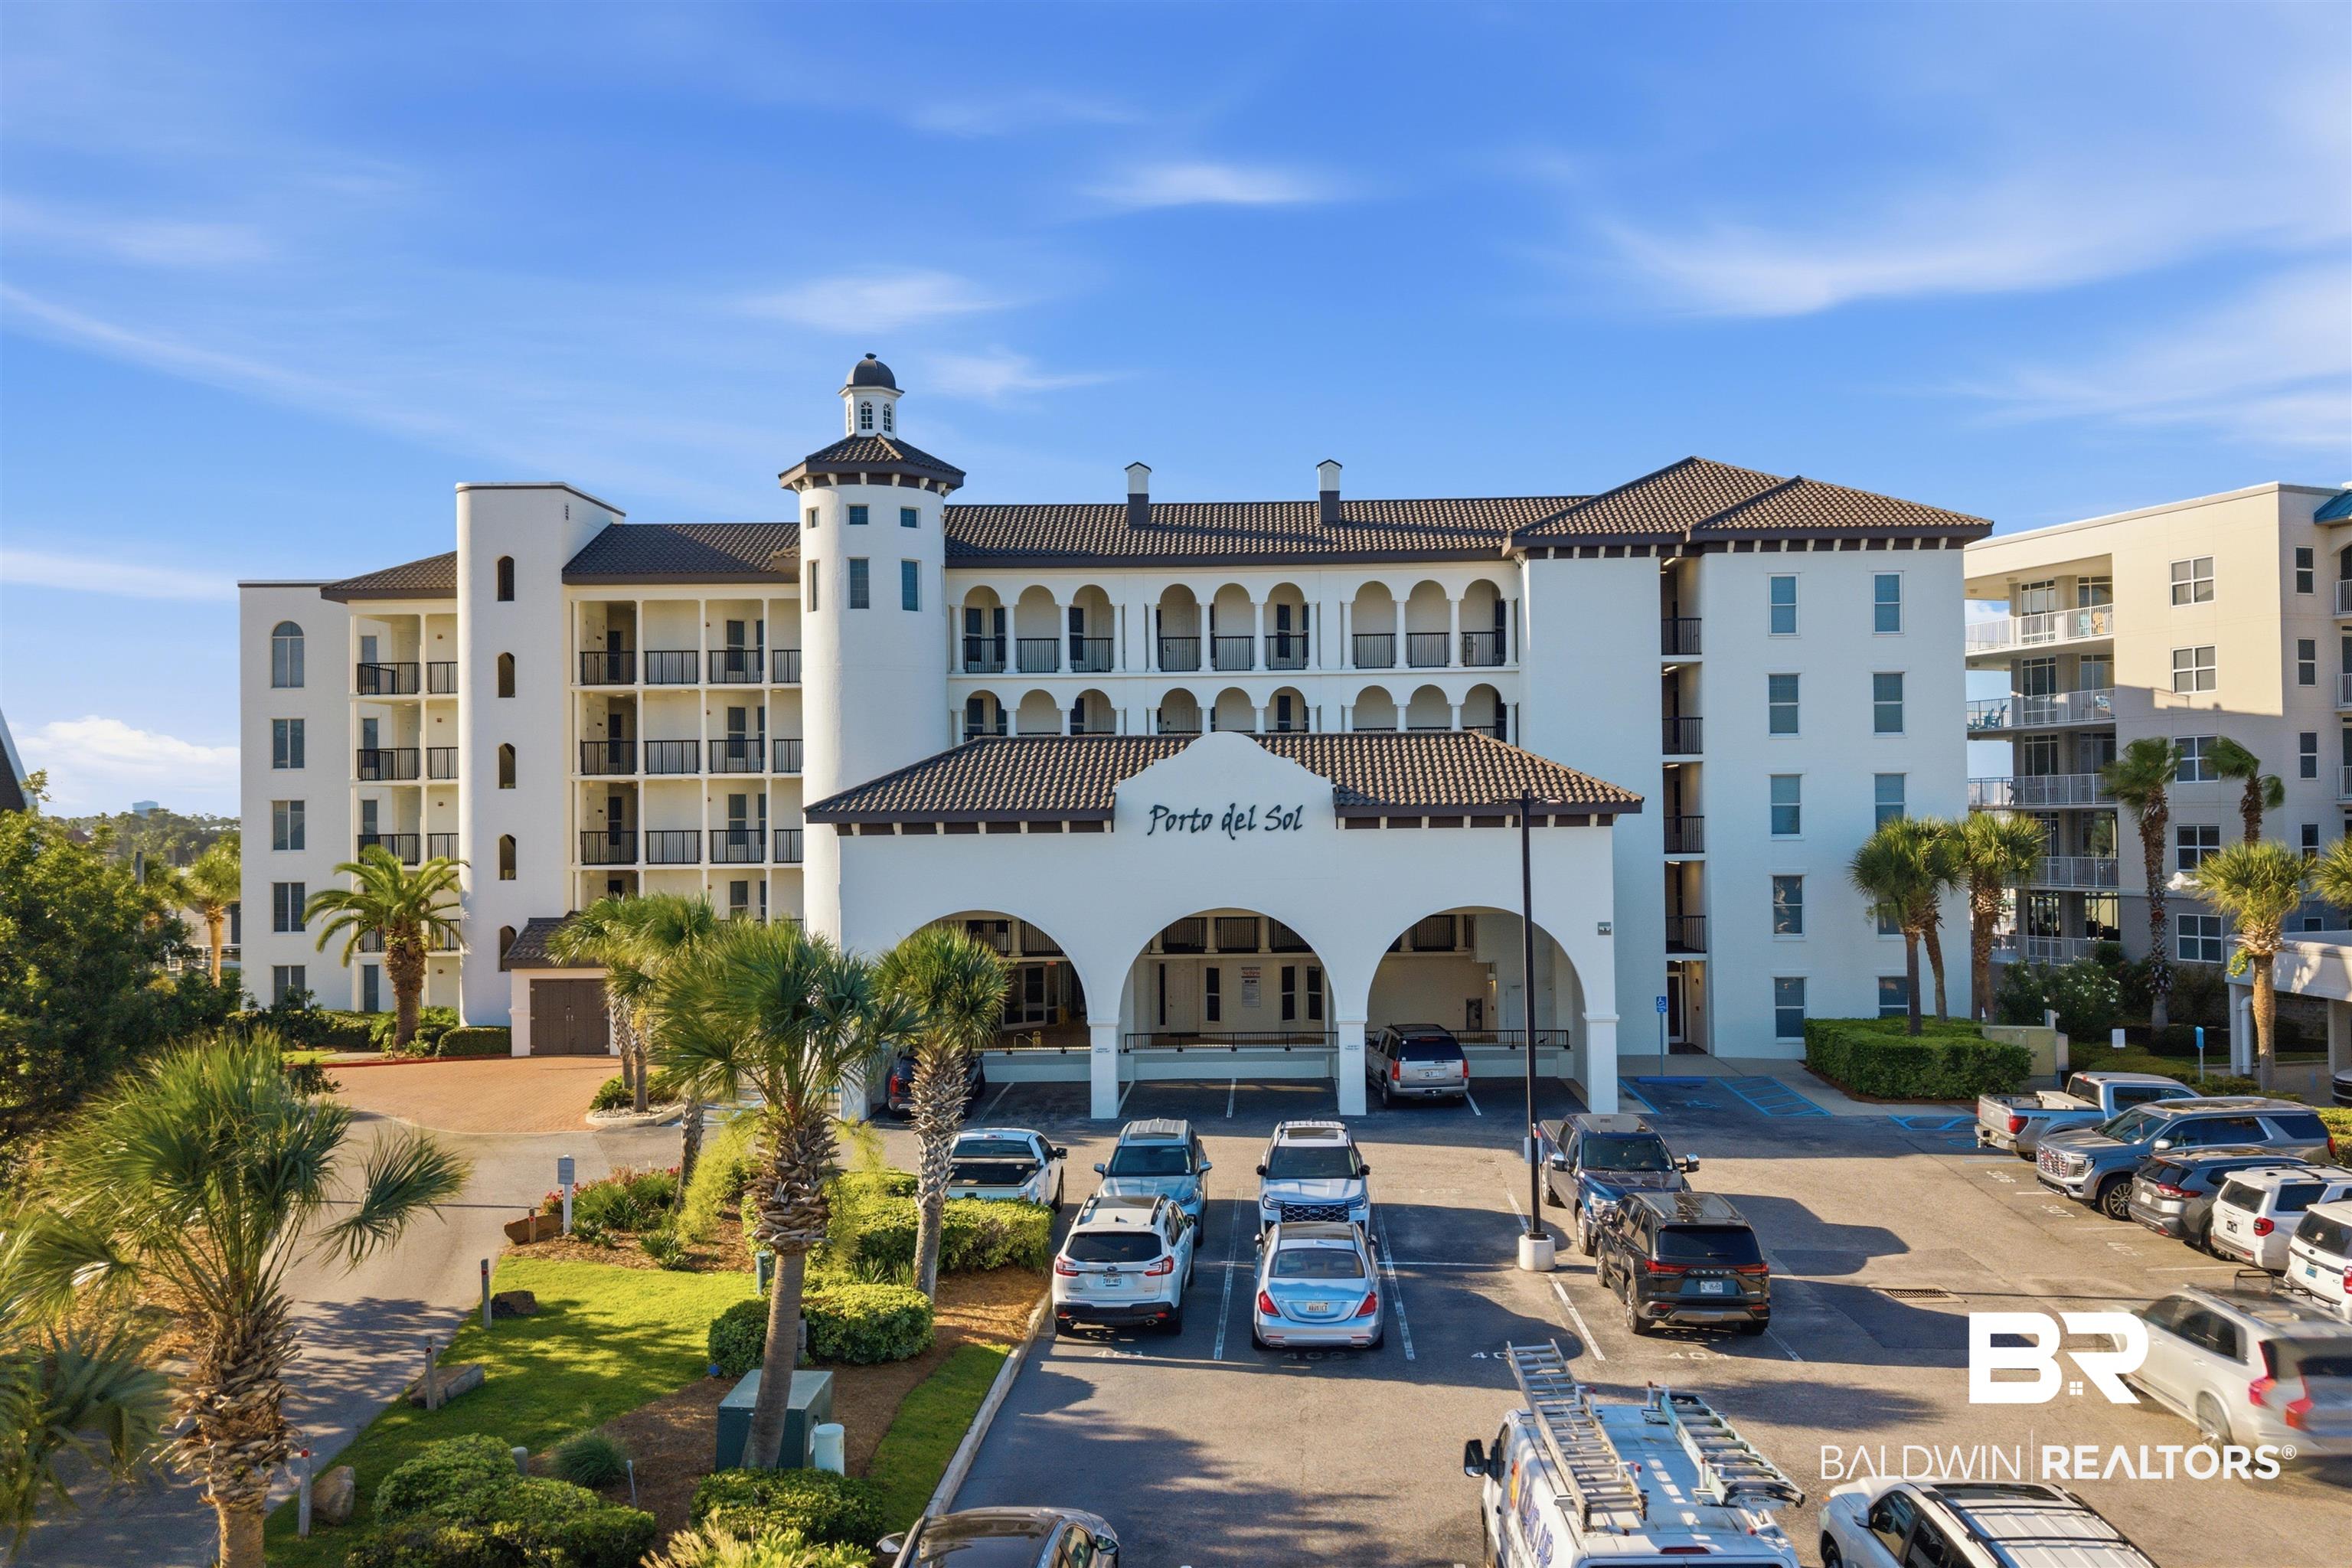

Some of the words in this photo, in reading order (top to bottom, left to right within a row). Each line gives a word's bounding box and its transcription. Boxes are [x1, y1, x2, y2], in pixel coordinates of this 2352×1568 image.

[1148, 804, 1213, 836] Porto
[1221, 802, 1256, 840] del
[1264, 804, 1303, 831] Sol
